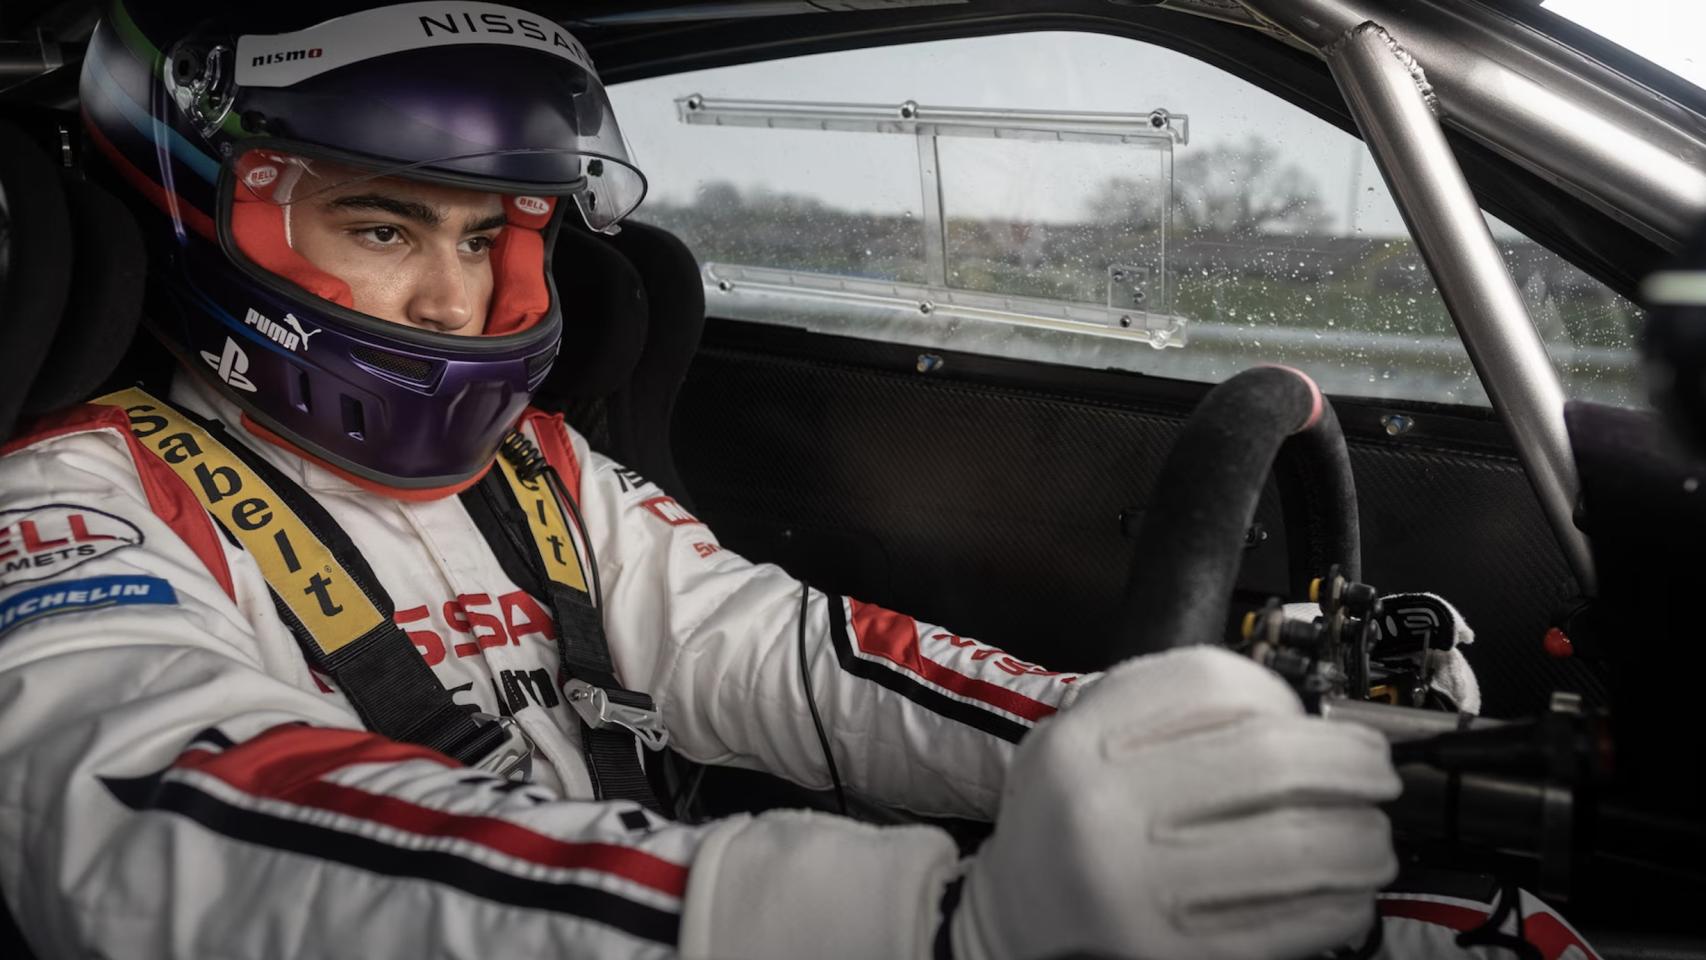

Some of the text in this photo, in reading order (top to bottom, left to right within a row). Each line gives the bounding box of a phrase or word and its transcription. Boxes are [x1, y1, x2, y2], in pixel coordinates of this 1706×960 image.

[252, 48, 323, 67] nismo
[418, 12, 594, 71] NISSAN
[250, 169, 275, 182] BELL
[518, 197, 545, 210] BELL
[244, 307, 300, 352] PUMA
[0, 584, 151, 629] ICHELIN
